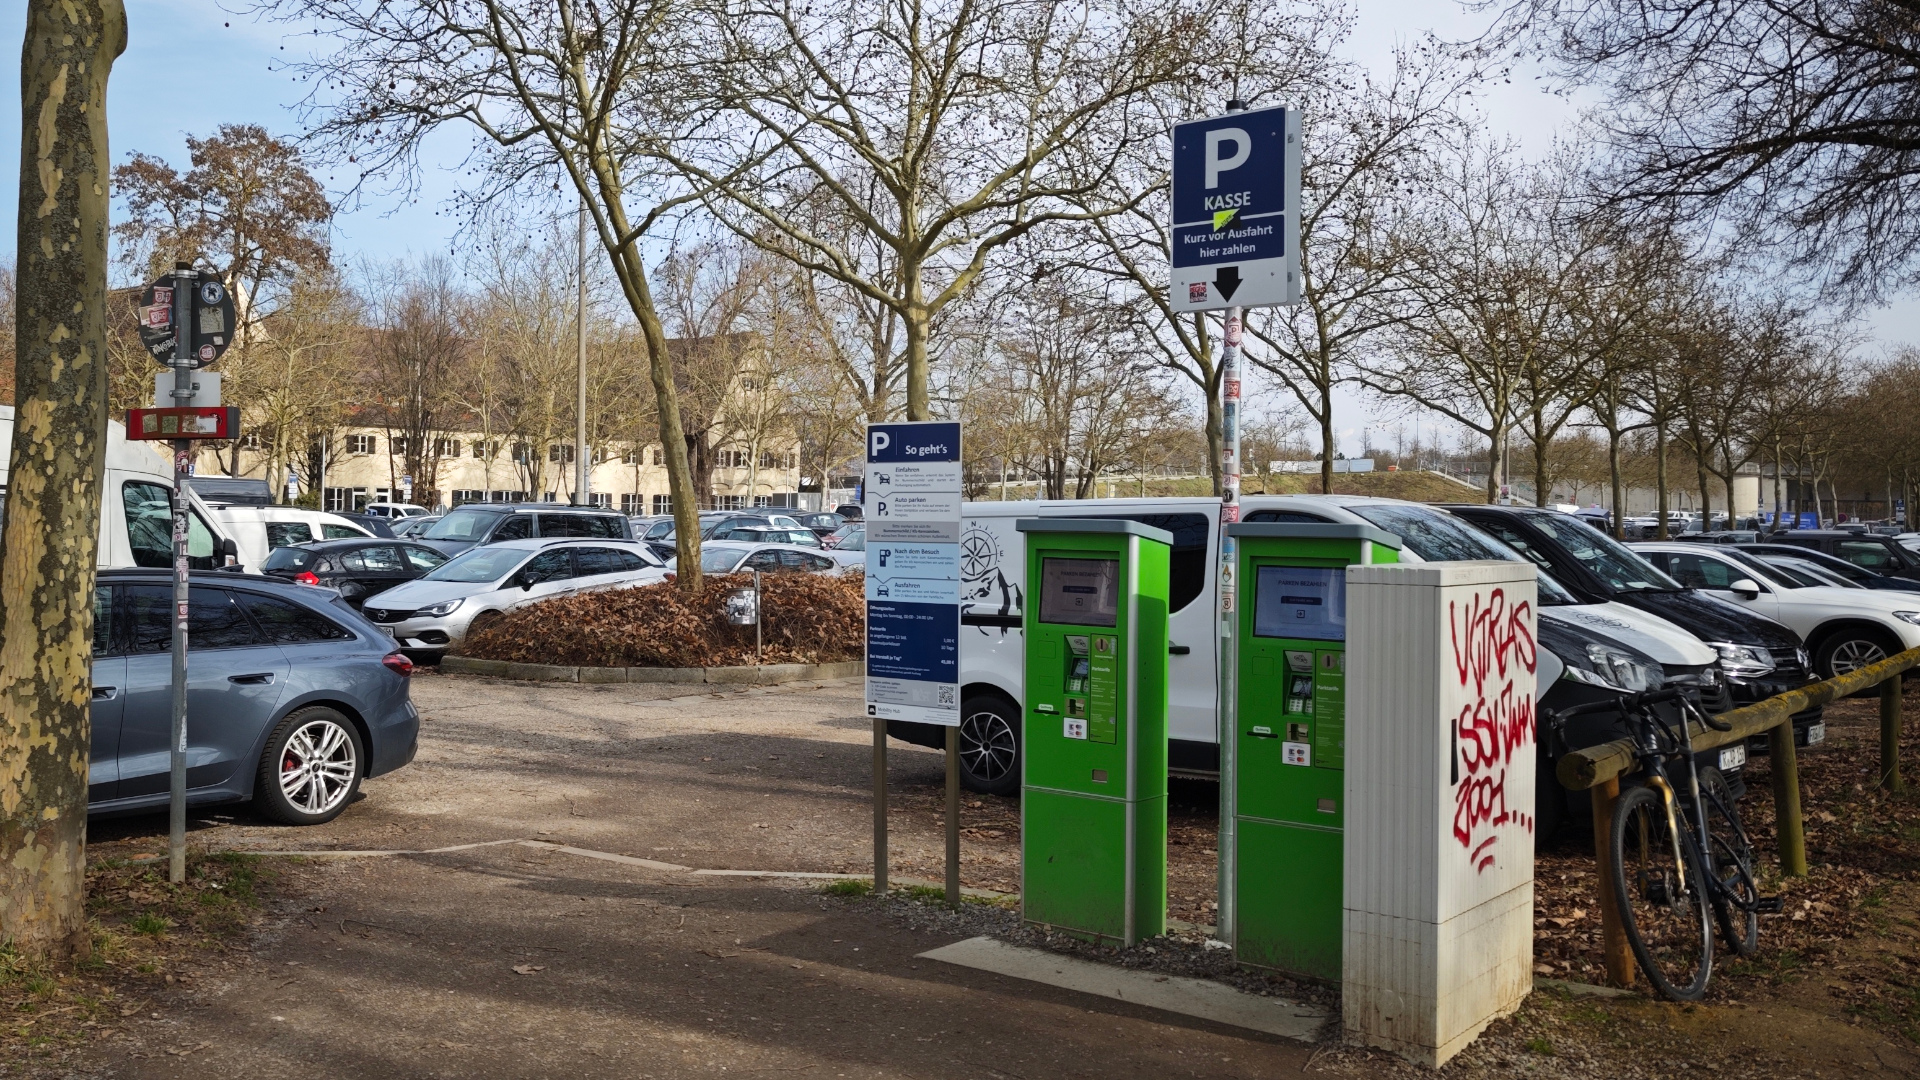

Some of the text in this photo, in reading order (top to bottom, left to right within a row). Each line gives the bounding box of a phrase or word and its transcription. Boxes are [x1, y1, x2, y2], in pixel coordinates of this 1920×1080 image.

[1205, 128, 1252, 190] P
[1204, 191, 1251, 210] KASSE
[1184, 225, 1273, 244] Kurz vor Ausfahrt
[1200, 243, 1256, 258] hier zahlen
[872, 432, 948, 457] P So geht's
